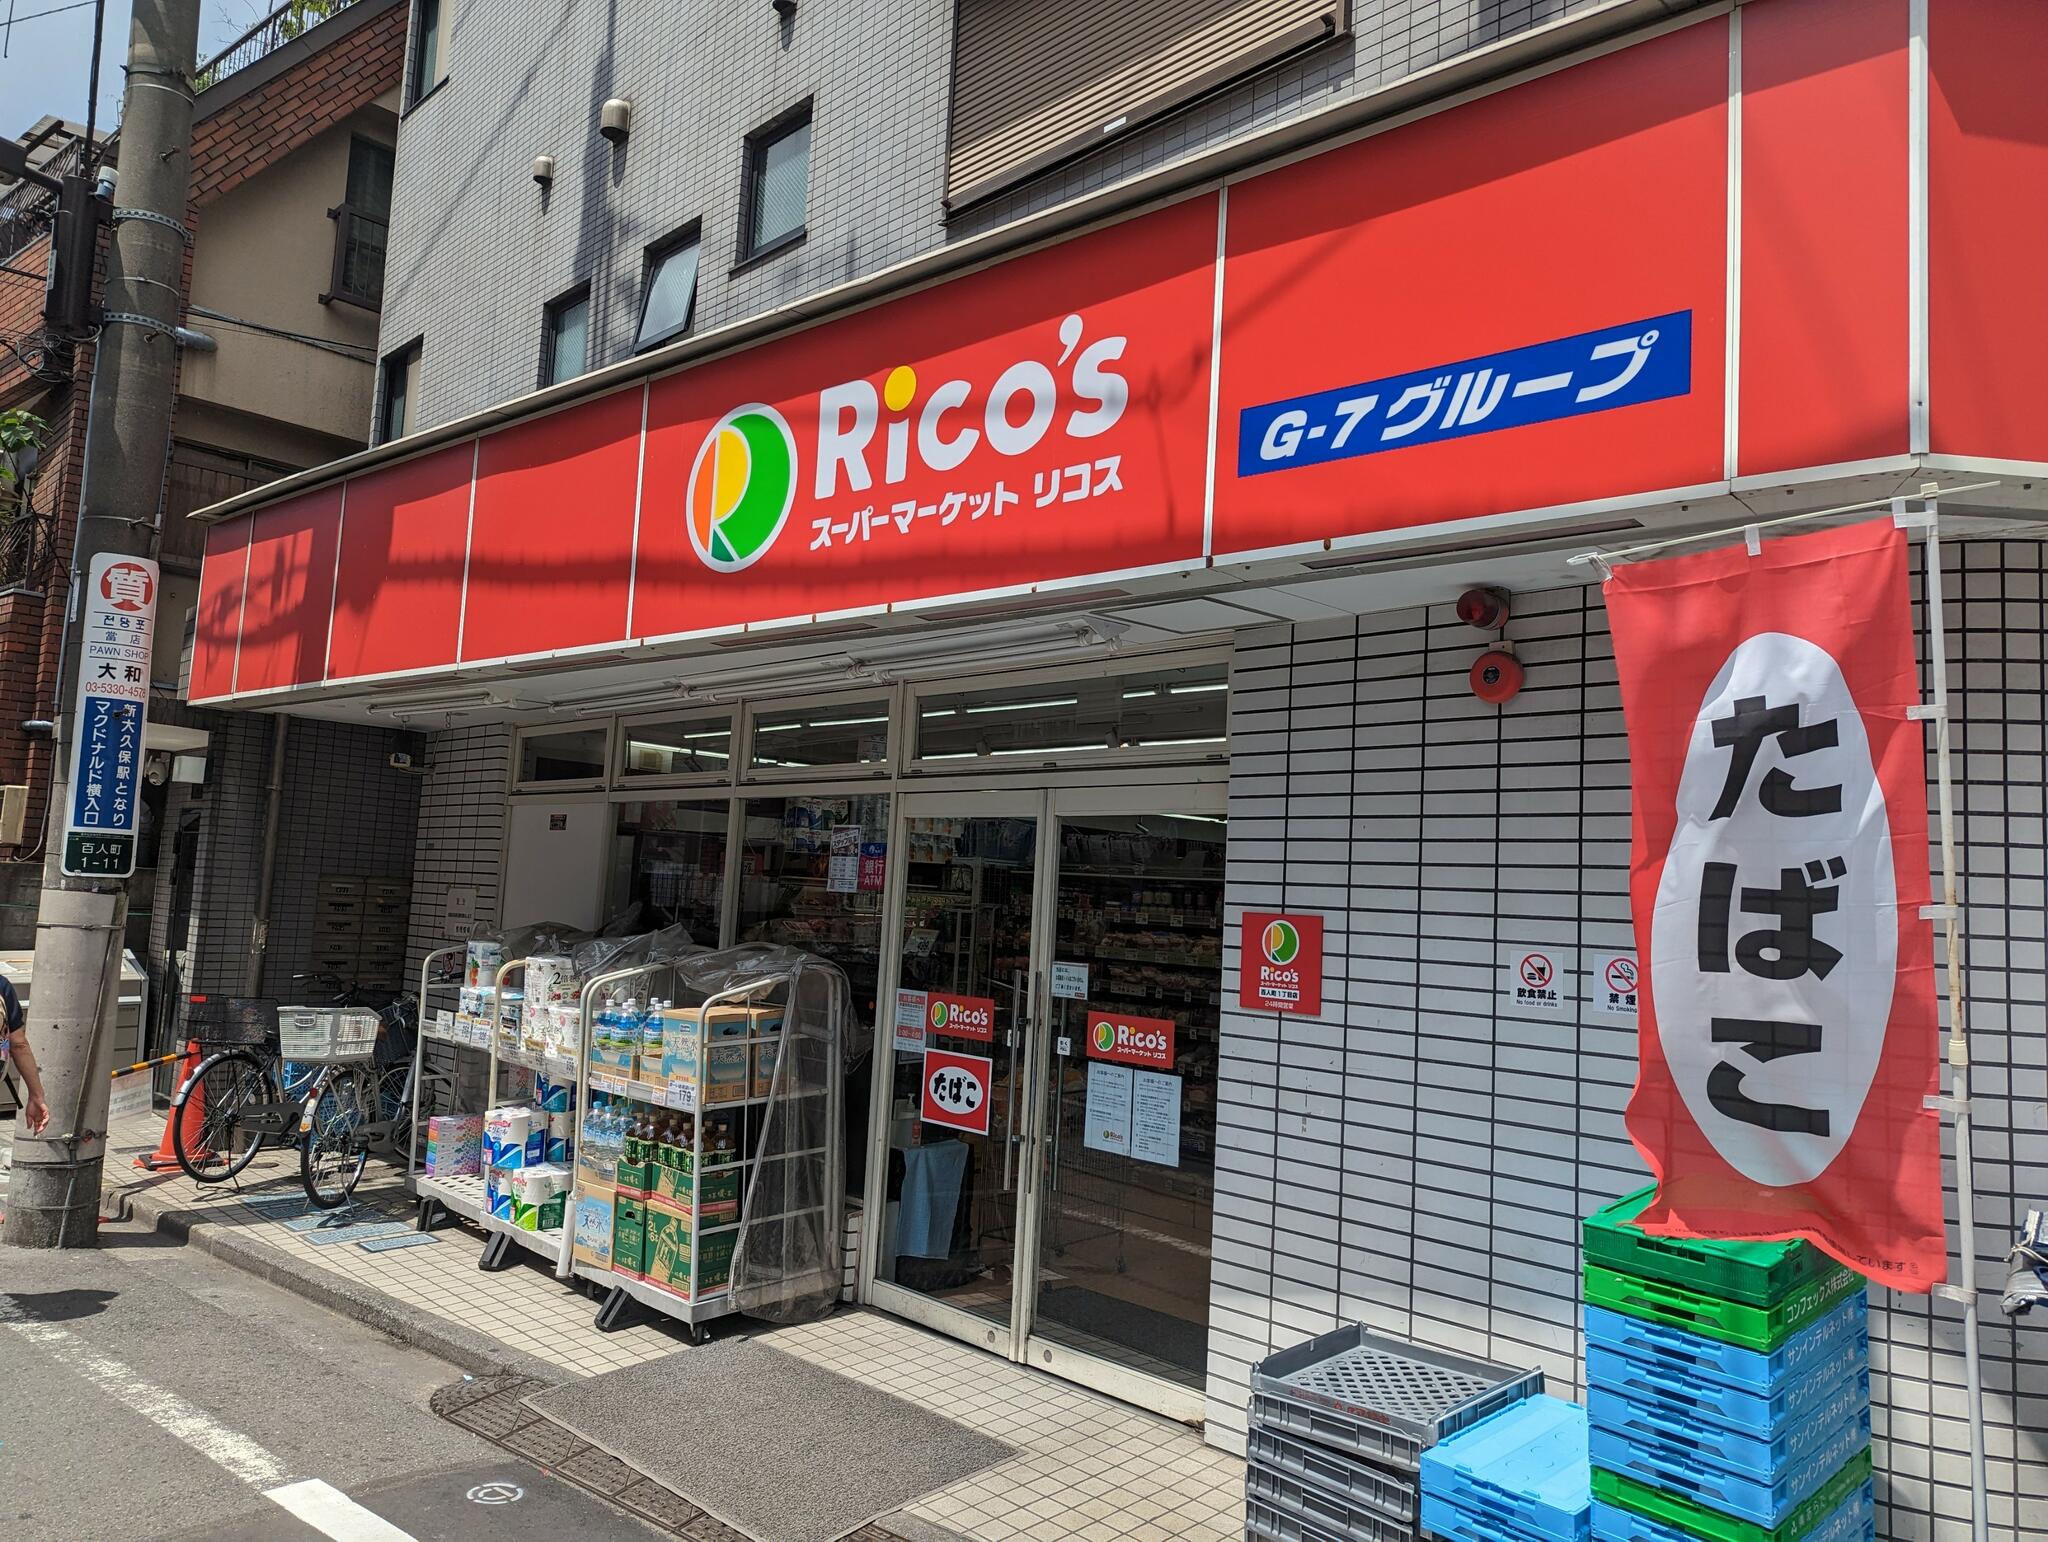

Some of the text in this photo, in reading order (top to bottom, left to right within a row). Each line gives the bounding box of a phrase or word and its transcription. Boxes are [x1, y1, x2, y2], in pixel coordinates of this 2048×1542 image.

[815, 314, 1129, 499] Rico's
[809, 455, 1124, 552] スーパーマーケット リコス
[106, 567, 150, 607] 質
[89, 645, 149, 660] PAWN SHOP
[98, 662, 142, 684] 大和
[83, 700, 111, 826] マクドナルド横入口
[112, 703, 137, 827] 新大久保駅となり
[81, 842, 122, 856] 百人町
[81, 857, 119, 870] 1-11
[864, 860, 884, 874] 銀行
[864, 876, 883, 886] ATM
[1697, 695, 1848, 1138] たばこ
[1261, 966, 1299, 983] Rico's
[1517, 988, 1557, 1001] 飲食禁止
[1609, 993, 1637, 1006] 禁煙
[949, 1004, 988, 1025] Rico's
[1117, 1025, 1167, 1051] Rico's
[1117, 1046, 1152, 1057] スーパーマーケット
[933, 1072, 977, 1109] たばこ
